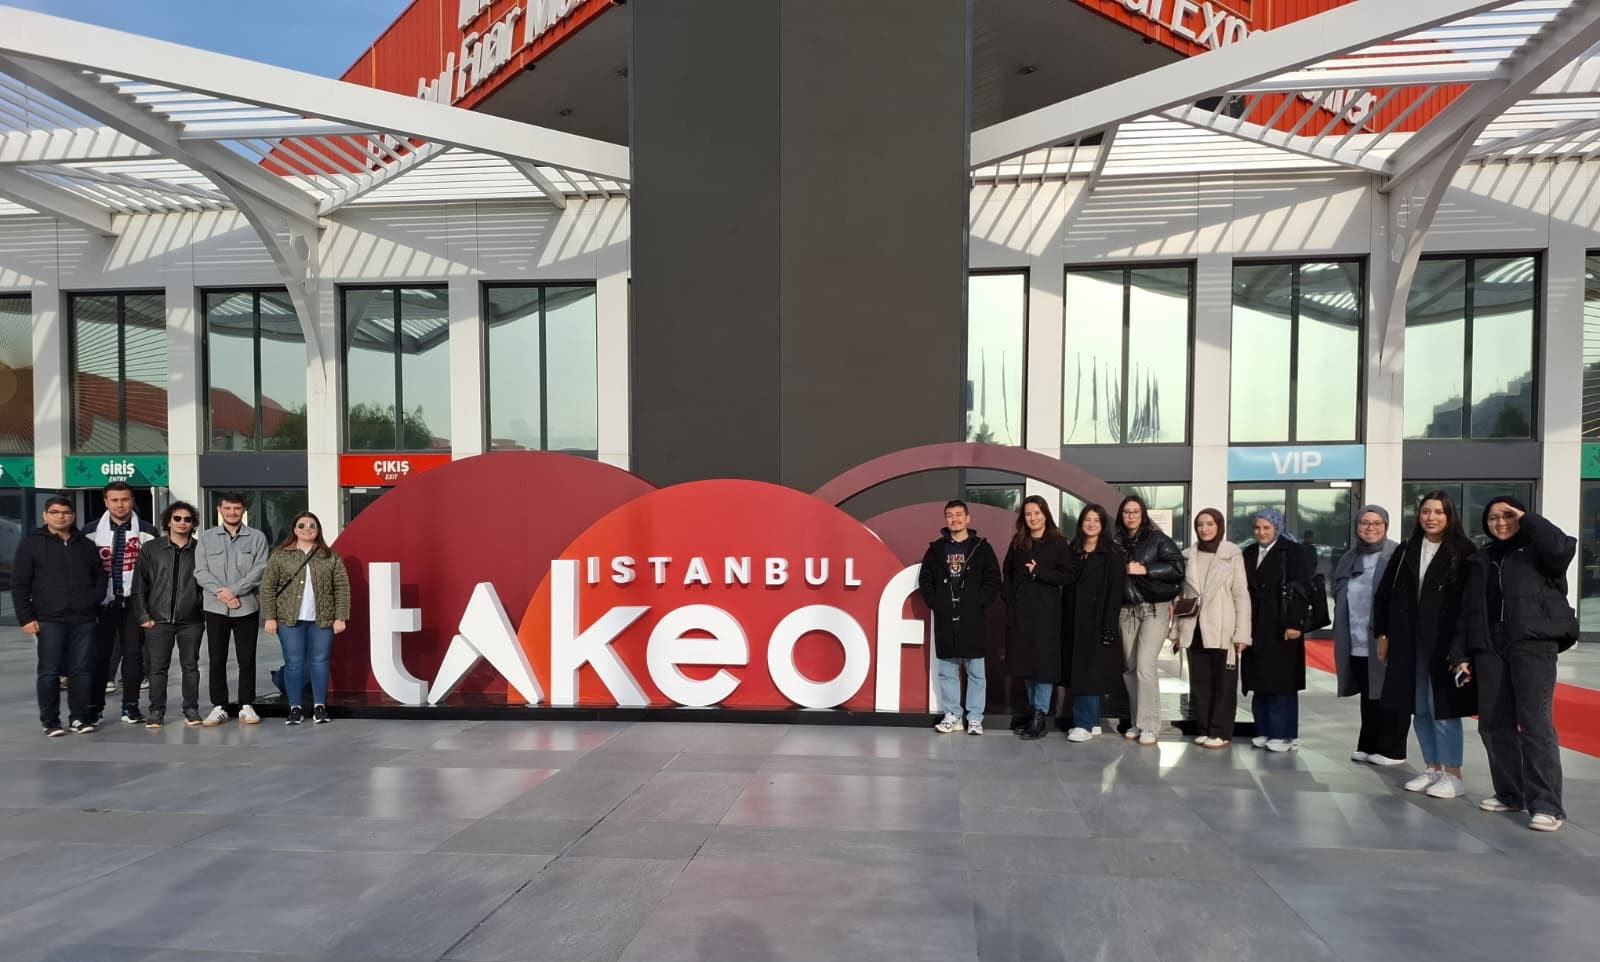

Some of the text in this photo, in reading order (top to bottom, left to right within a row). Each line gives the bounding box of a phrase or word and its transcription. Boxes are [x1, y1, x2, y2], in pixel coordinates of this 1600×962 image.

[457, 6, 521, 99] Fuar
[101, 460, 135, 478] GİRİŞ
[374, 460, 410, 476] ÇIKIŞ
[1271, 451, 1323, 475] VIP
[587, 556, 862, 586] ISTANBUL
[767, 563, 942, 713] of
